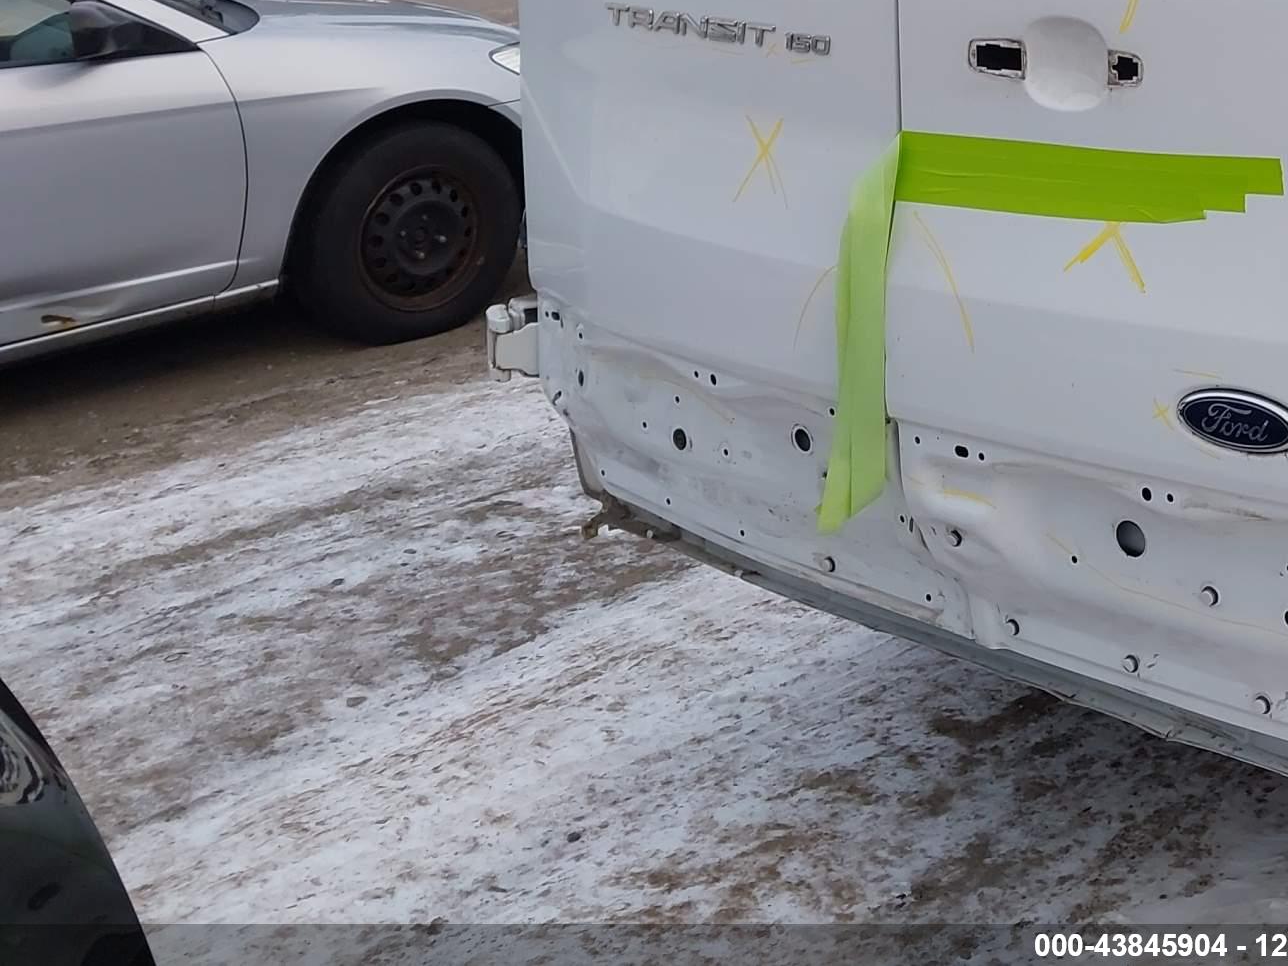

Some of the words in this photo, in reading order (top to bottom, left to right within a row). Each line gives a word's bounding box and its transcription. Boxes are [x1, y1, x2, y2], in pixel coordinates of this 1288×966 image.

[604, 1, 777, 48] TRANSIT
[784, 31, 832, 57] 150
[1200, 402, 1270, 443] Ford
